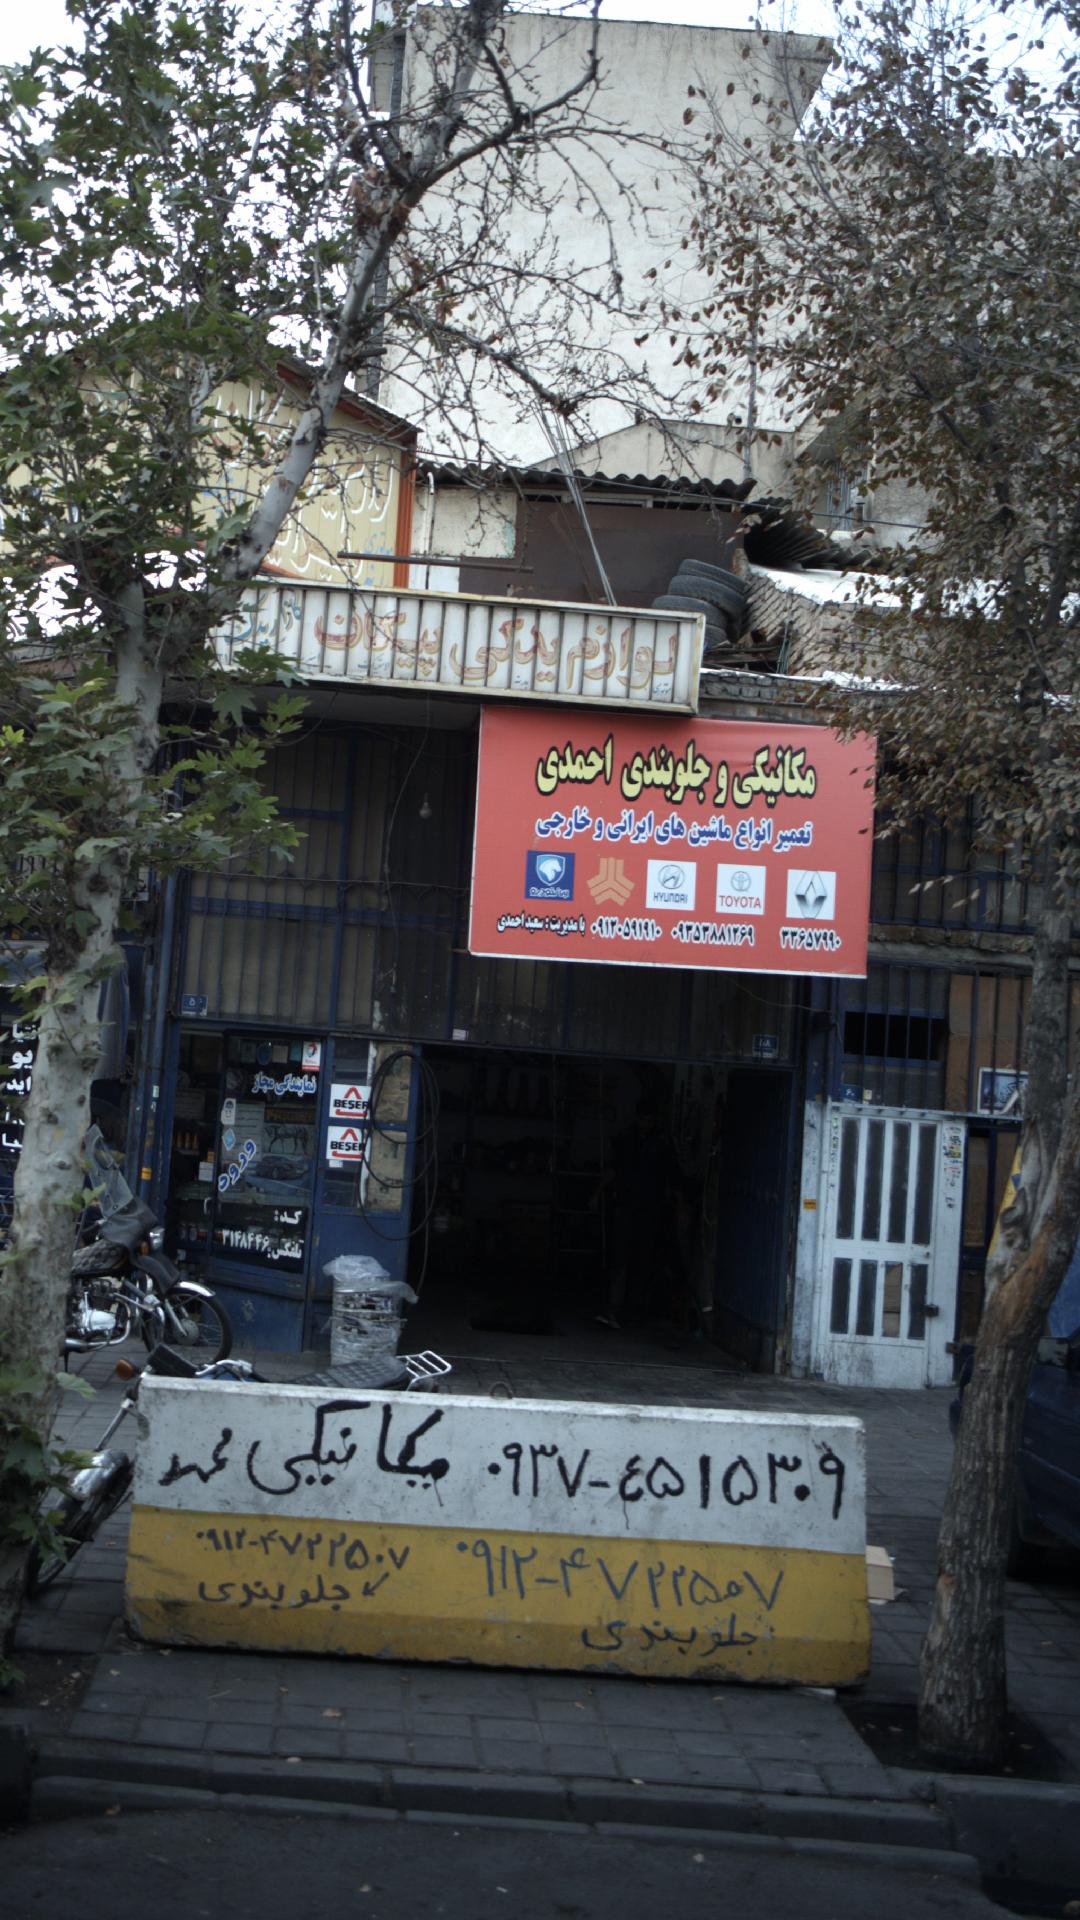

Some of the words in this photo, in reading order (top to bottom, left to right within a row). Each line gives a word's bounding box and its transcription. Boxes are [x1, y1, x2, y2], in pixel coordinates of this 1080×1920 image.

[314, 609, 442, 677] پیکان
[451, 617, 559, 681] یدکی
[567, 624, 678, 689] لوازم
[535, 731, 614, 796] احمدی
[620, 737, 712, 804] جلوبندی
[731, 743, 817, 809] مکانیکی
[713, 761, 729, 807] و
[536, 806, 593, 838] خارجی
[593, 815, 604, 840] و
[607, 810, 654, 843] ایرانی
[654, 812, 686, 845] های
[687, 814, 732, 846] ماشین
[733, 816, 773, 851] انواع
[774, 820, 813, 851] تعمیر
[653, 891, 688, 904] HYUNDAI
[719, 895, 761, 908] TOYOTA
[497, 910, 525, 933] احمدی
[525, 913, 545, 934] سعید
[251, 1070, 275, 1093] مجاز
[274, 1073, 317, 1097] نمایندگی
[218, 1139, 256, 1192] ورود
